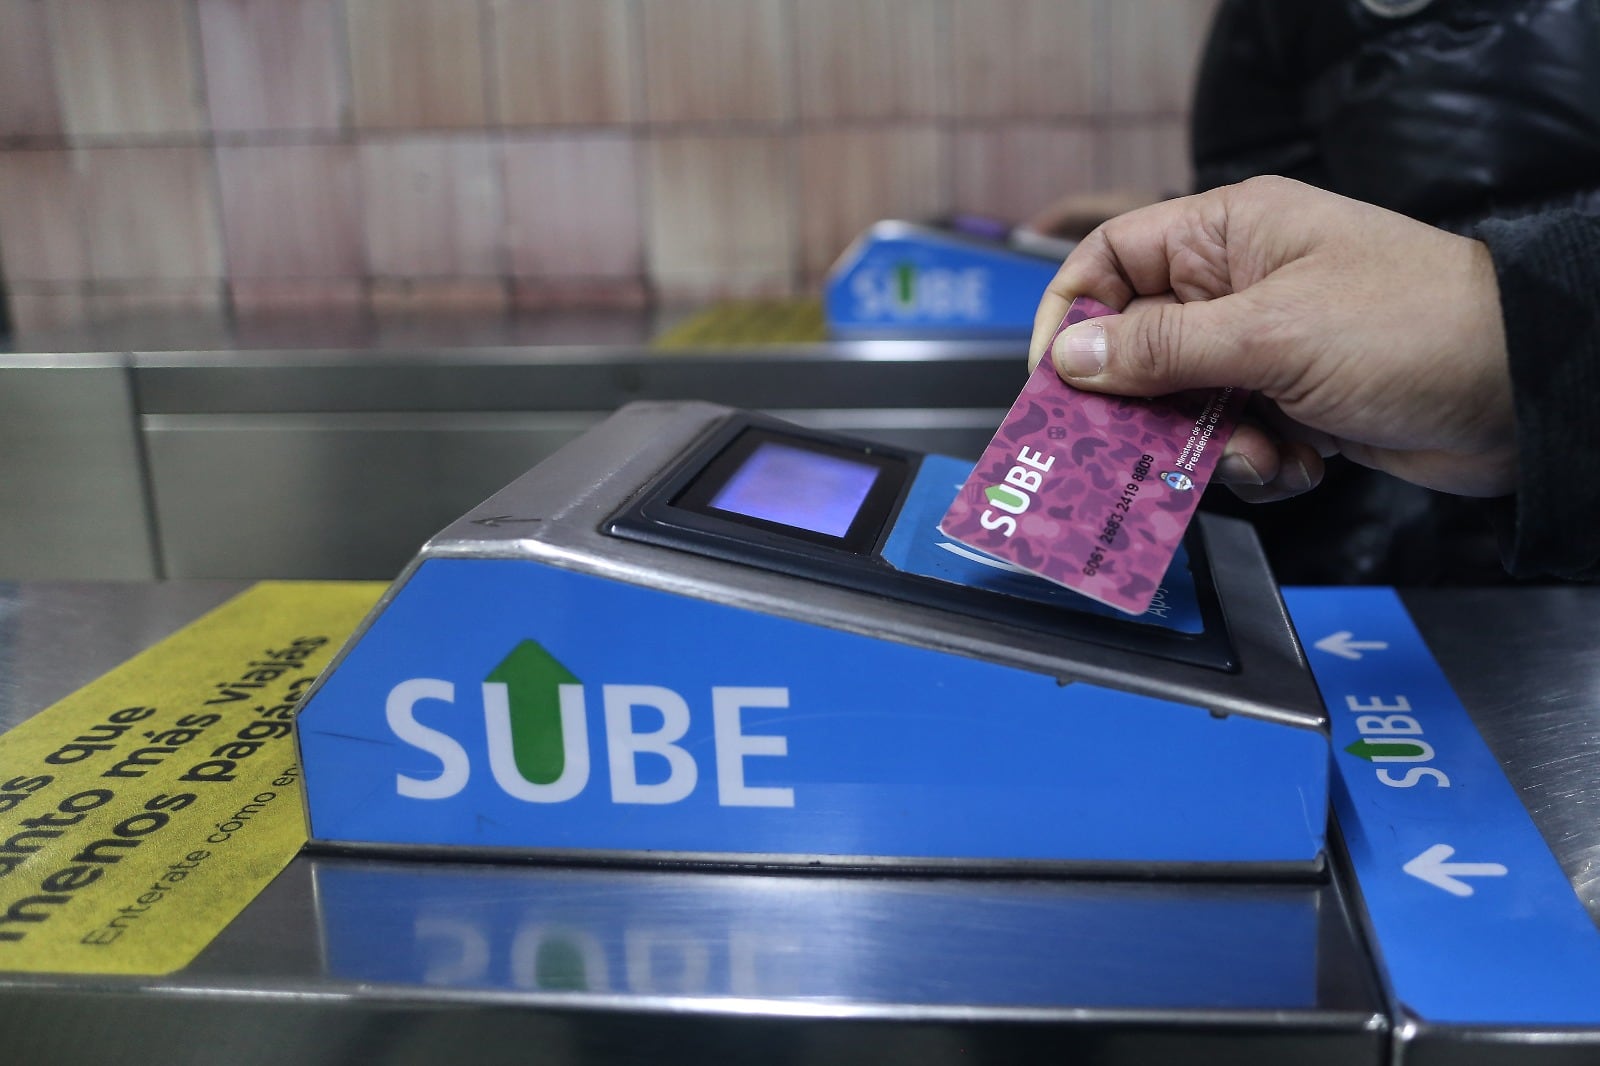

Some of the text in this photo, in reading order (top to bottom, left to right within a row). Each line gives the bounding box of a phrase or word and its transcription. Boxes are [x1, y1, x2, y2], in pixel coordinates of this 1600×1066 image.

[853, 266, 990, 322] SUBE
[1175, 436, 1196, 467] Ministerio
[1192, 426, 1201, 436] de
[1184, 424, 1215, 471] Presidencia
[1209, 412, 1220, 423] de
[980, 445, 1056, 537] SUBE
[1083, 545, 1107, 576] 6061
[1116, 483, 1139, 512] 2419
[1132, 454, 1154, 482] 8809
[45, 707, 156, 764] que
[101, 714, 222, 777] más
[204, 636, 329, 705] viajás
[386, 678, 795, 807] SUBE
[1345, 694, 1451, 788] SUBE
[0, 793, 197, 941] menos
[80, 851, 210, 945] Enterate
[207, 792, 276, 843] cómo
